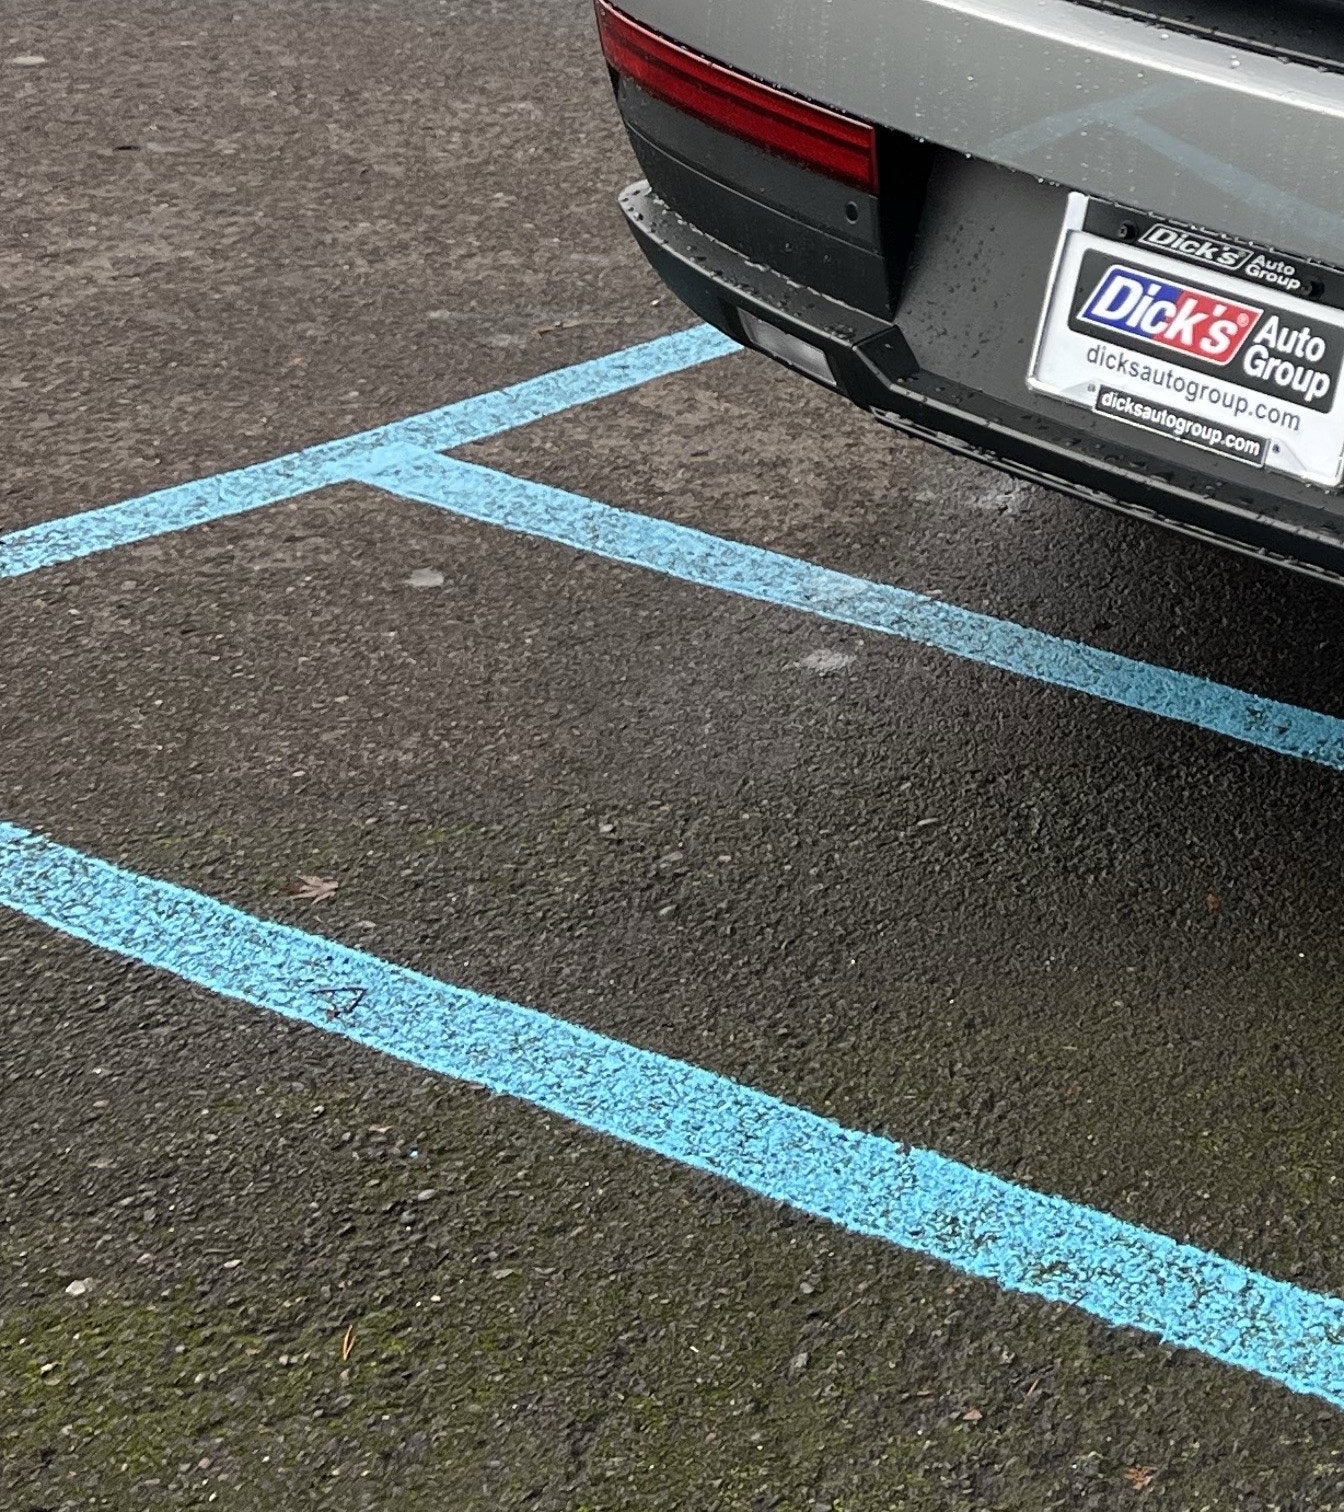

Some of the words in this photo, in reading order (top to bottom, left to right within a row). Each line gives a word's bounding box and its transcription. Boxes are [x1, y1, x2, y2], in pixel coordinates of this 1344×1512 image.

[1149, 227, 1240, 266] Dick's
[1251, 254, 1296, 276] Auto
[1244, 264, 1301, 290] Group
[1091, 275, 1239, 355] Dick's
[1253, 315, 1326, 362] Auto
[1086, 344, 1301, 431] dicksautogroup.com
[1243, 344, 1331, 402] Group
[1101, 391, 1261, 457] dicksautogroup.com
